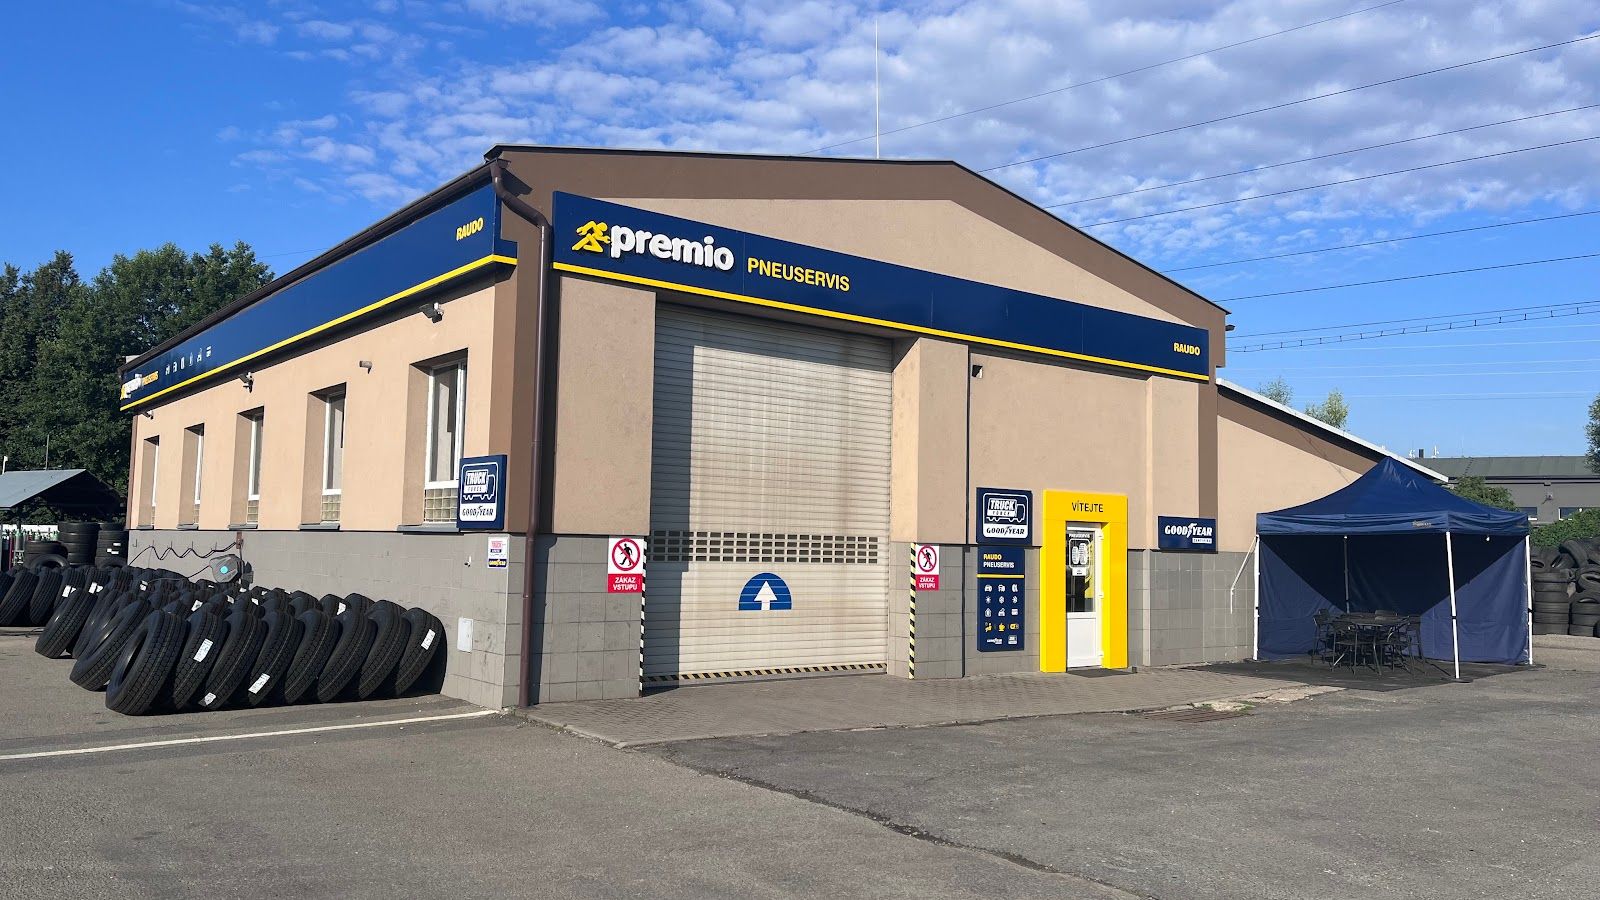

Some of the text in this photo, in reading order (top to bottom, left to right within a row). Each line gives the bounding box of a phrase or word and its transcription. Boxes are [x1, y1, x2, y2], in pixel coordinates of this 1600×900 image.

[456, 217, 484, 241] RAUDO
[610, 225, 850, 292] premio PNEUSERVIS
[1173, 342, 1201, 356] RAUDO
[466, 471, 487, 485] TRUCK
[990, 500, 1015, 510] TRUCK
[1071, 500, 1104, 513] VÍTEJTE
[986, 526, 1025, 535] GOODYEAR
[1164, 522, 1213, 539] GOODYEAR
[615, 576, 636, 584] ZÁKAZ
[613, 583, 638, 591] VSTUPU
